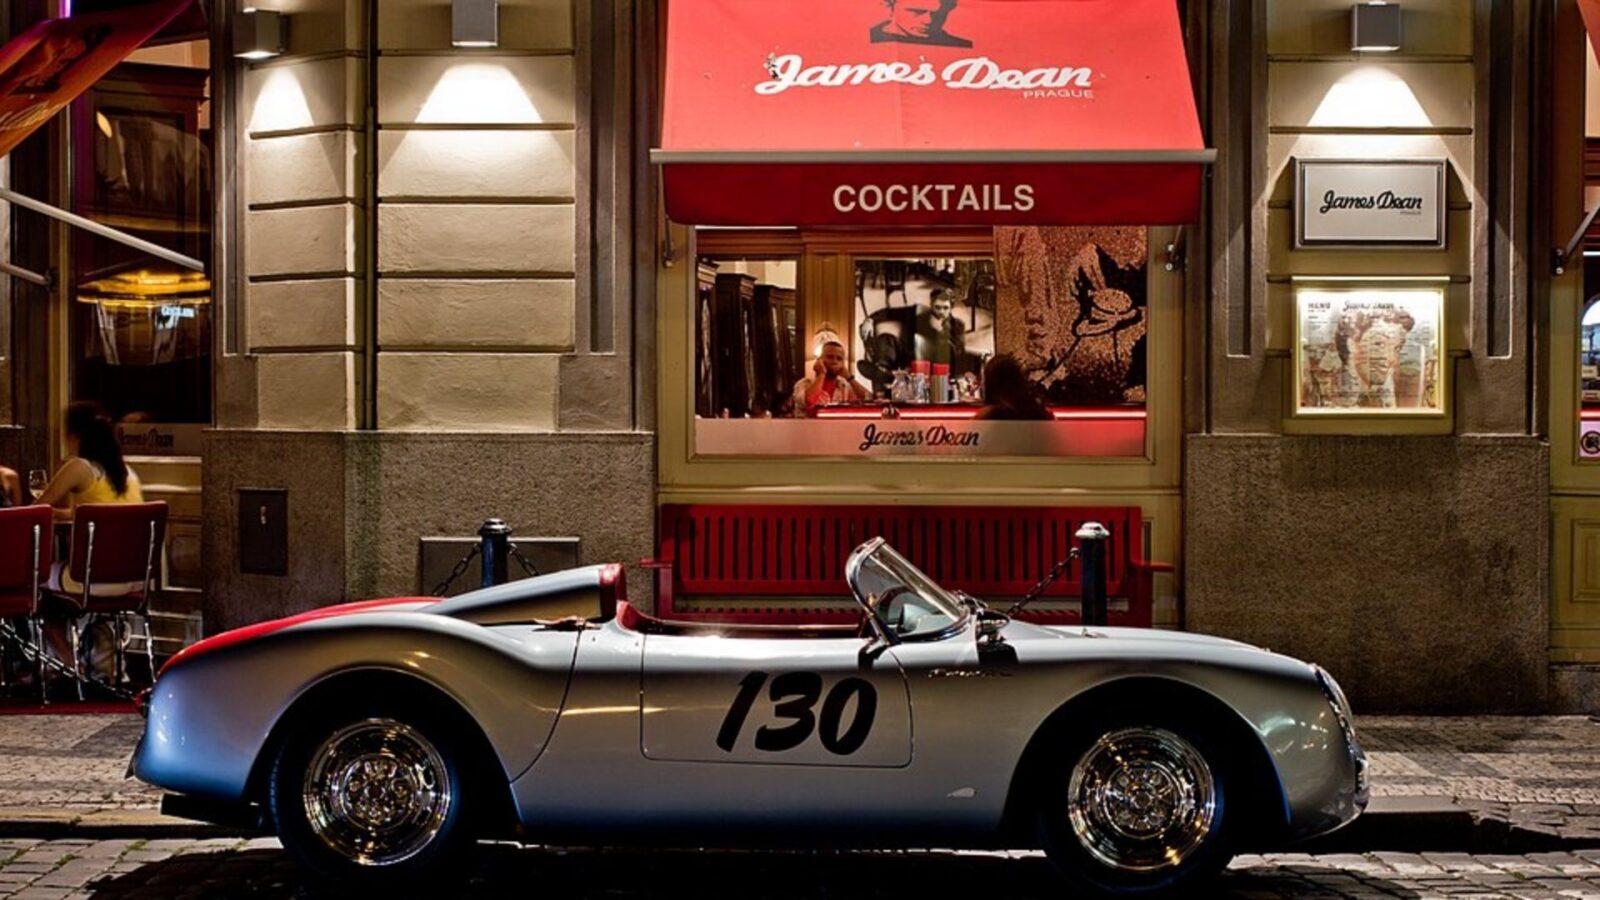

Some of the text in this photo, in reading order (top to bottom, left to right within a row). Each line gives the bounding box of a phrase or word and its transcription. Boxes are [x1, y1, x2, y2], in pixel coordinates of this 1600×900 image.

[940, 56, 1093, 90] Dean
[1023, 89, 1094, 98] PRAGUE
[832, 184, 1035, 213] COCKTAILS
[1320, 190, 1423, 213] James Dean
[859, 423, 979, 450] James Dean
[716, 671, 878, 756] 130
